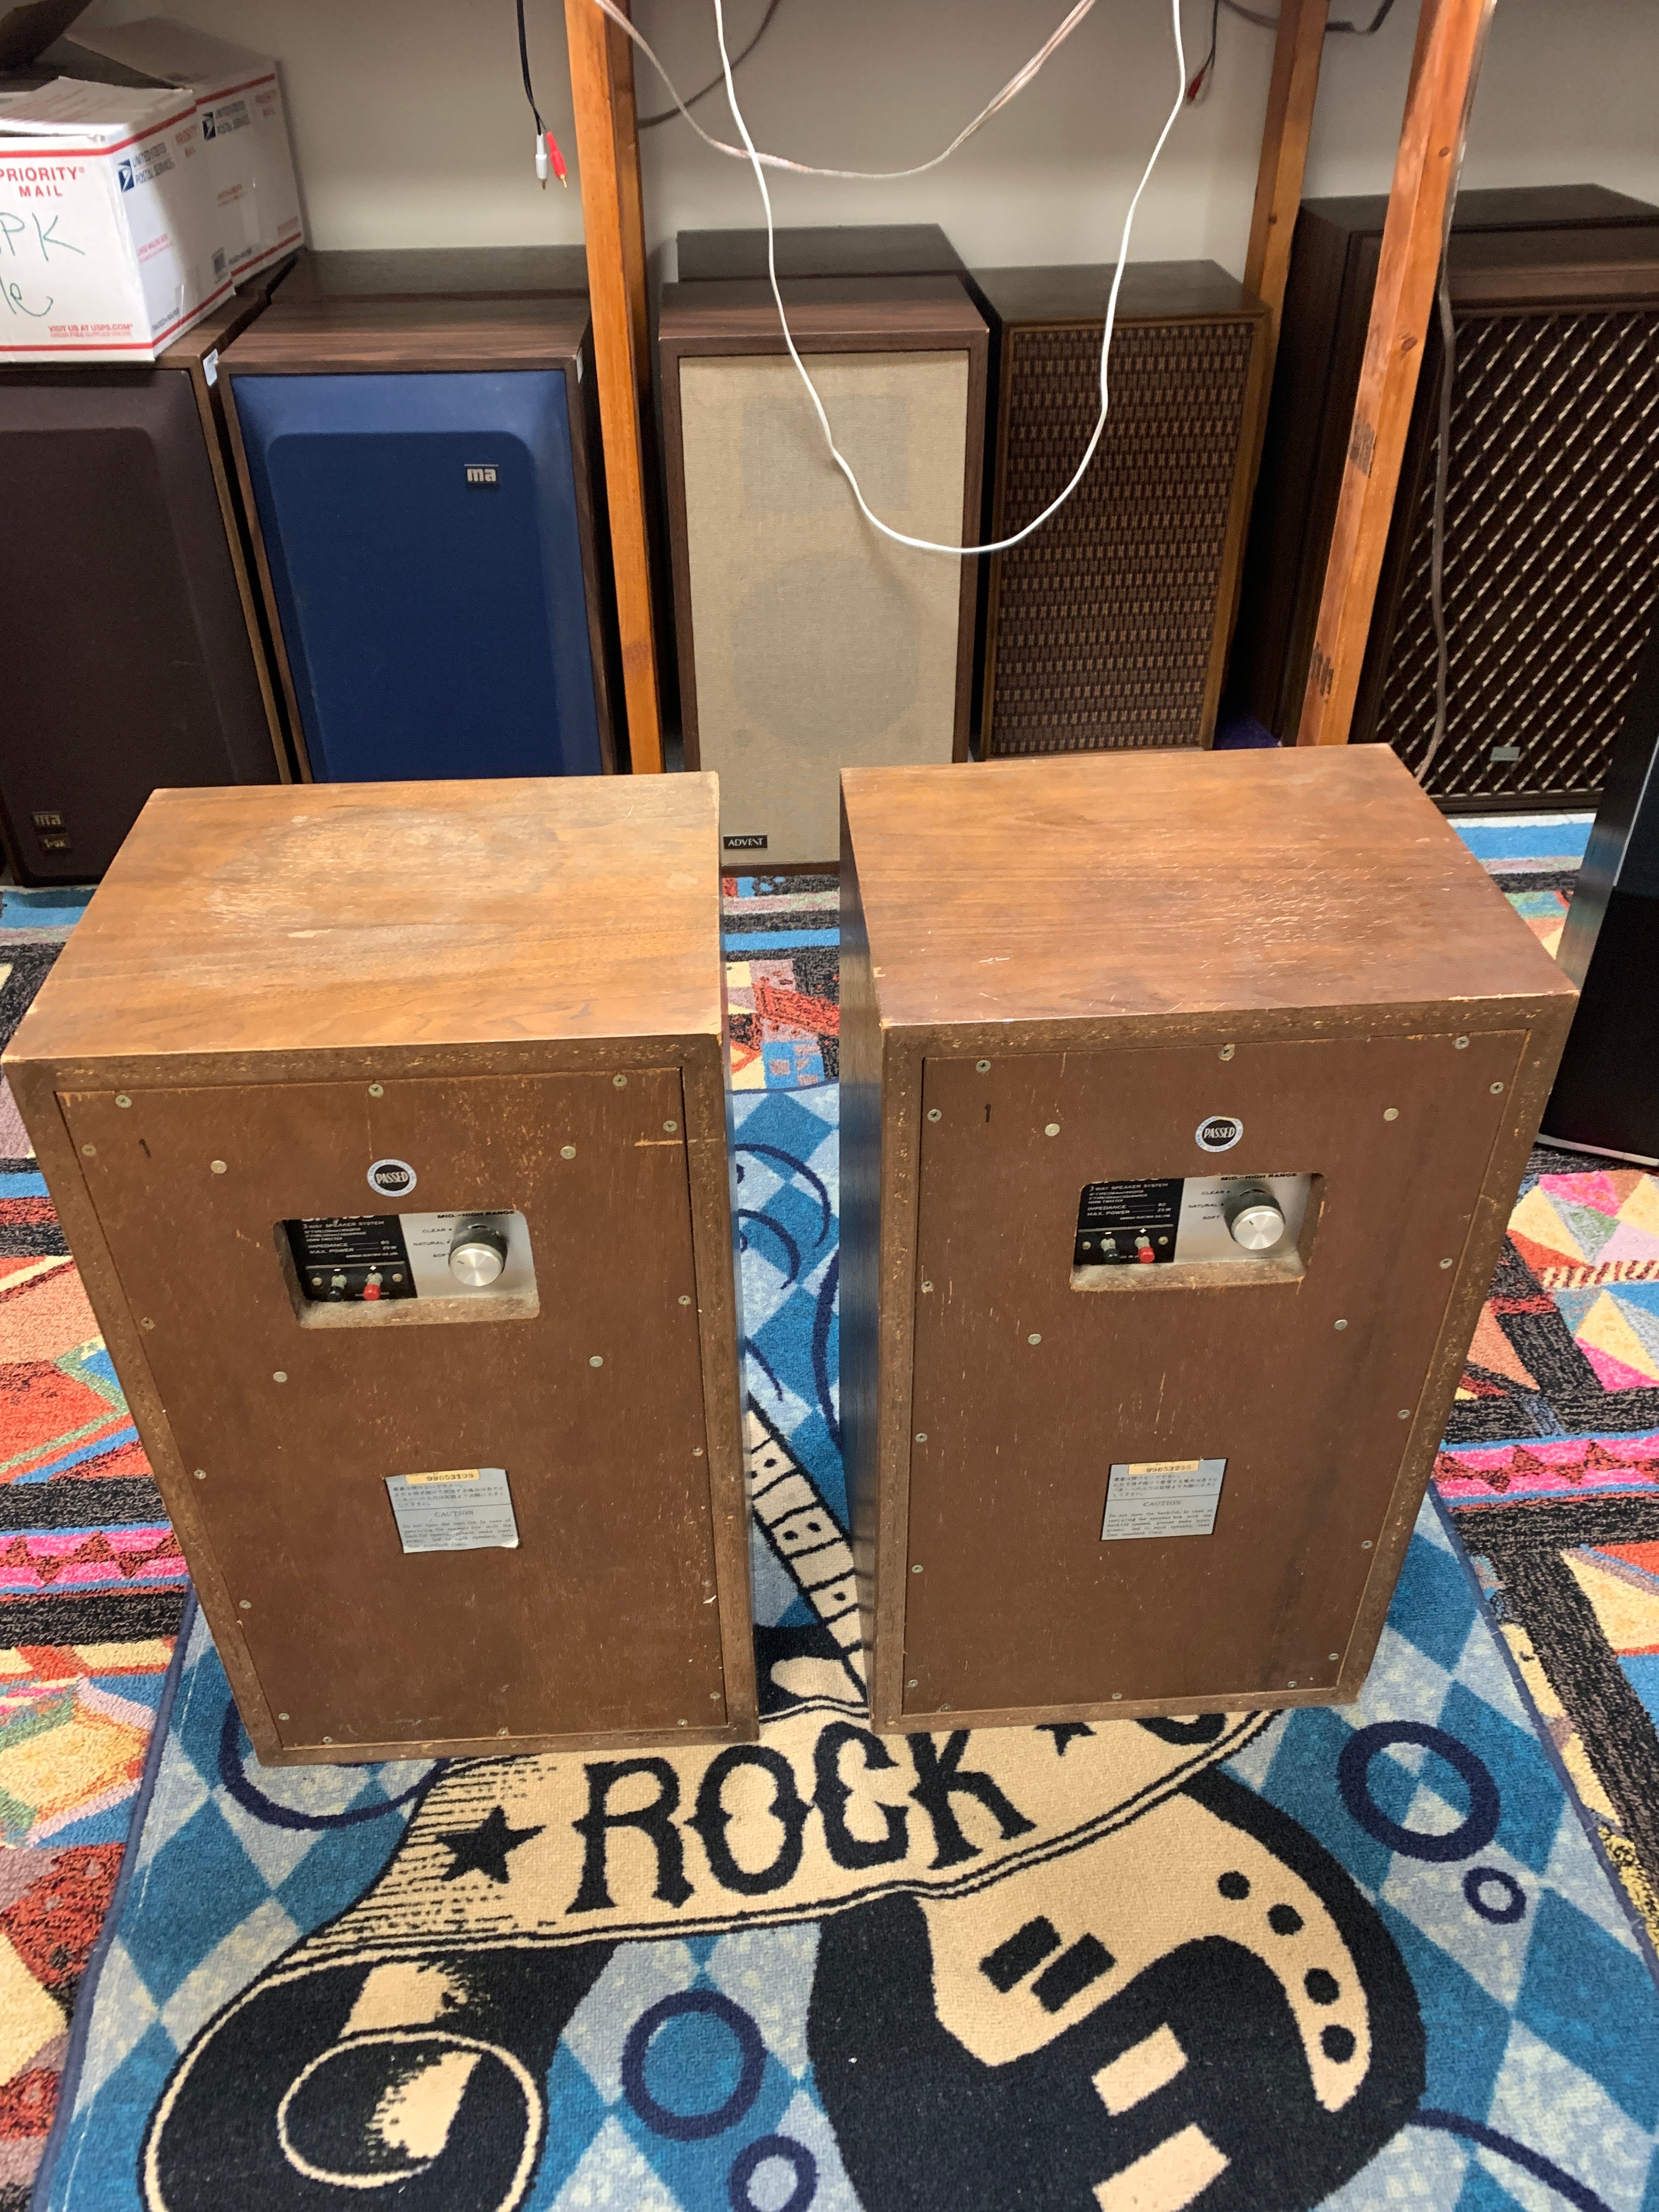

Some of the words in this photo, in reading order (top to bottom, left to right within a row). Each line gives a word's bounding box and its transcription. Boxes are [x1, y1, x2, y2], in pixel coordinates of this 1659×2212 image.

[19, 185, 63, 197] MAIL
[728, 837, 764, 847] ADVENT
[1203, 1127, 1235, 1138] PASSED
[375, 1171, 408, 1184] PASSED
[565, 1720, 1035, 1912] ROCK
